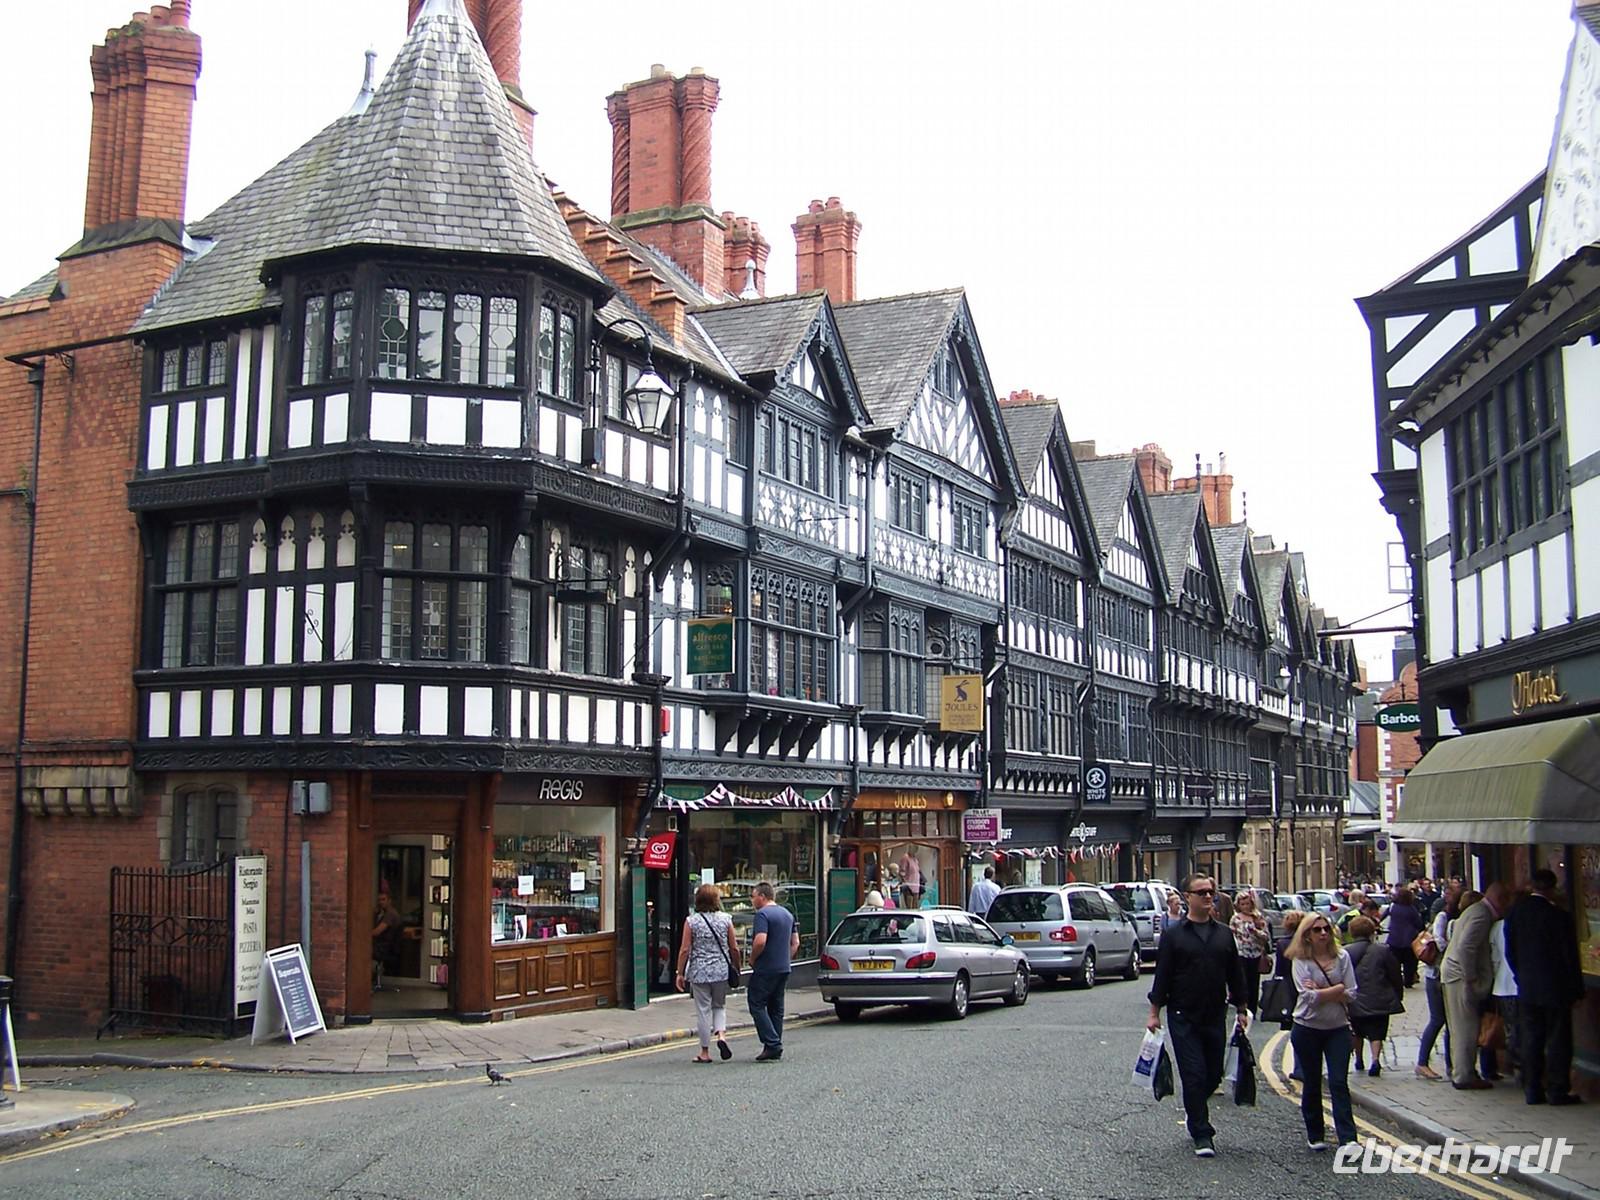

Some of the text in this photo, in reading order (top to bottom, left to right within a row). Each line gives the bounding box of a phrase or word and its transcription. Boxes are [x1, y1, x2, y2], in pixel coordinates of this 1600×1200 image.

[945, 703, 978, 712] JOULES
[894, 792, 928, 809] JOULES
[243, 878, 259, 890] Sergio
[243, 922, 257, 934] PASTA
[239, 941, 262, 953] PIZZERIA
